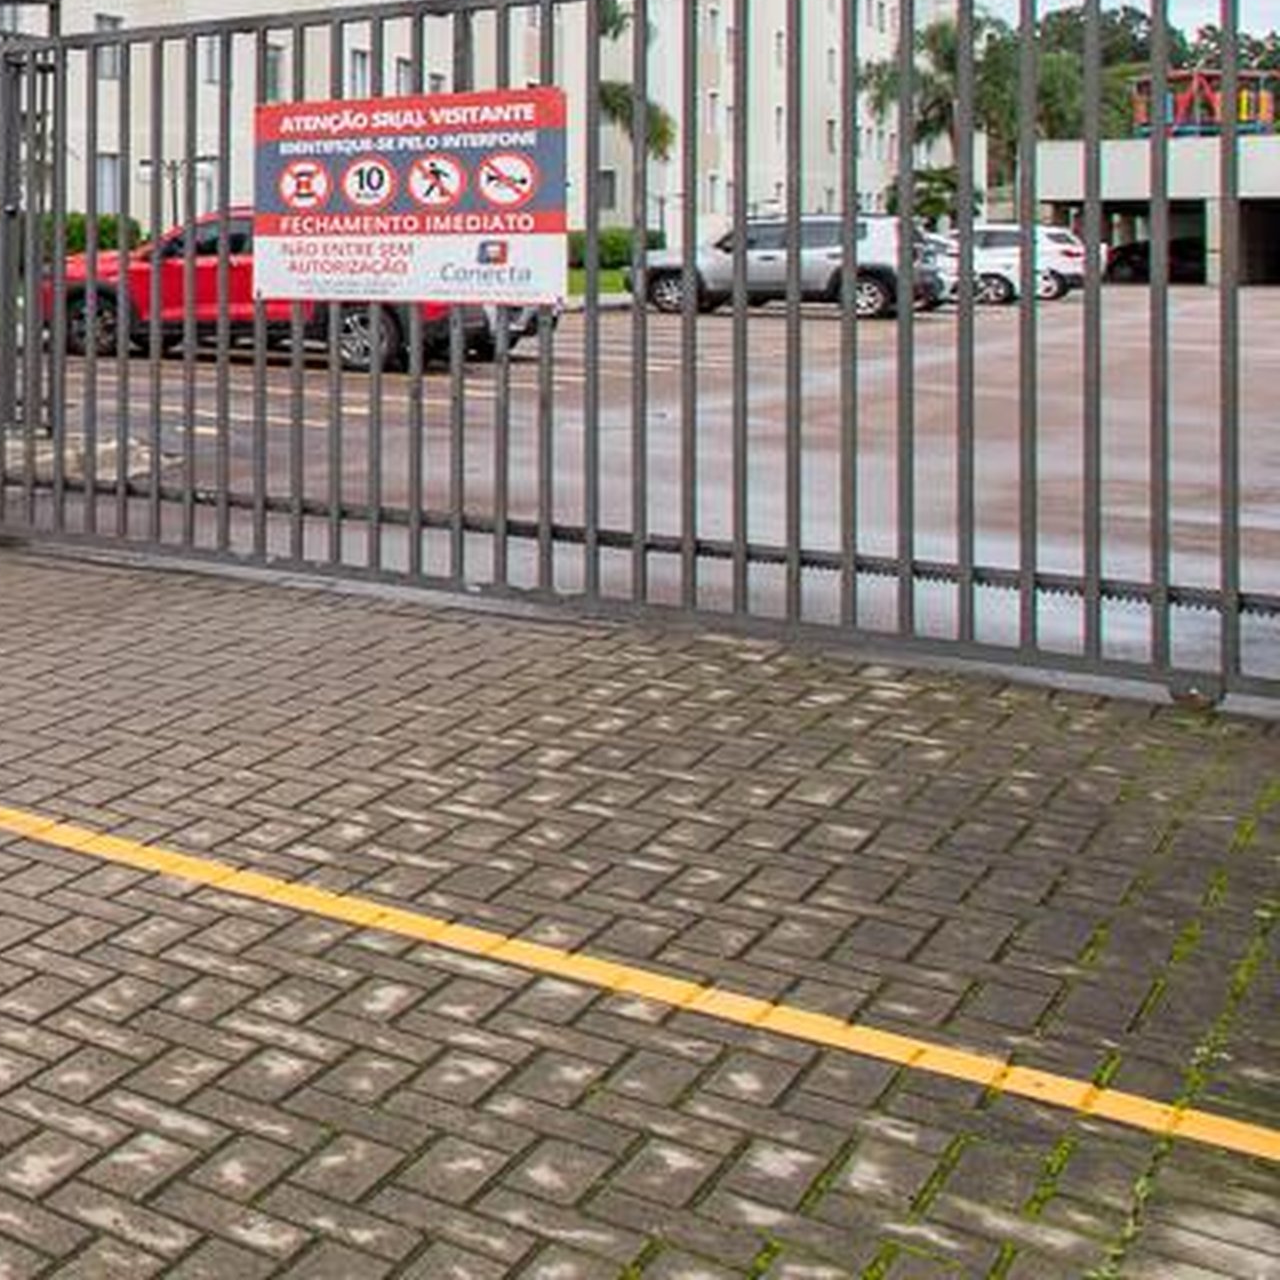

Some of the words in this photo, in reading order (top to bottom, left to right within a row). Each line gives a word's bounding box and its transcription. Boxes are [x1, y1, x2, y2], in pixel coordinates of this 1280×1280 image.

[280, 108, 368, 134] ATENÇÃO
[428, 103, 535, 125] VISITANTE
[279, 136, 394, 155] IDENTIFIQUE-SE
[397, 134, 438, 151] PELO
[441, 129, 536, 148] INTERFONE
[353, 166, 384, 190] 10
[280, 215, 419, 234] FECHAMENTO
[426, 214, 535, 232] IMEDIATO
[281, 239, 318, 256] NÃO
[322, 241, 373, 257] ENTRE
[378, 241, 414, 258] SEM
[440, 263, 532, 284] Conecta
